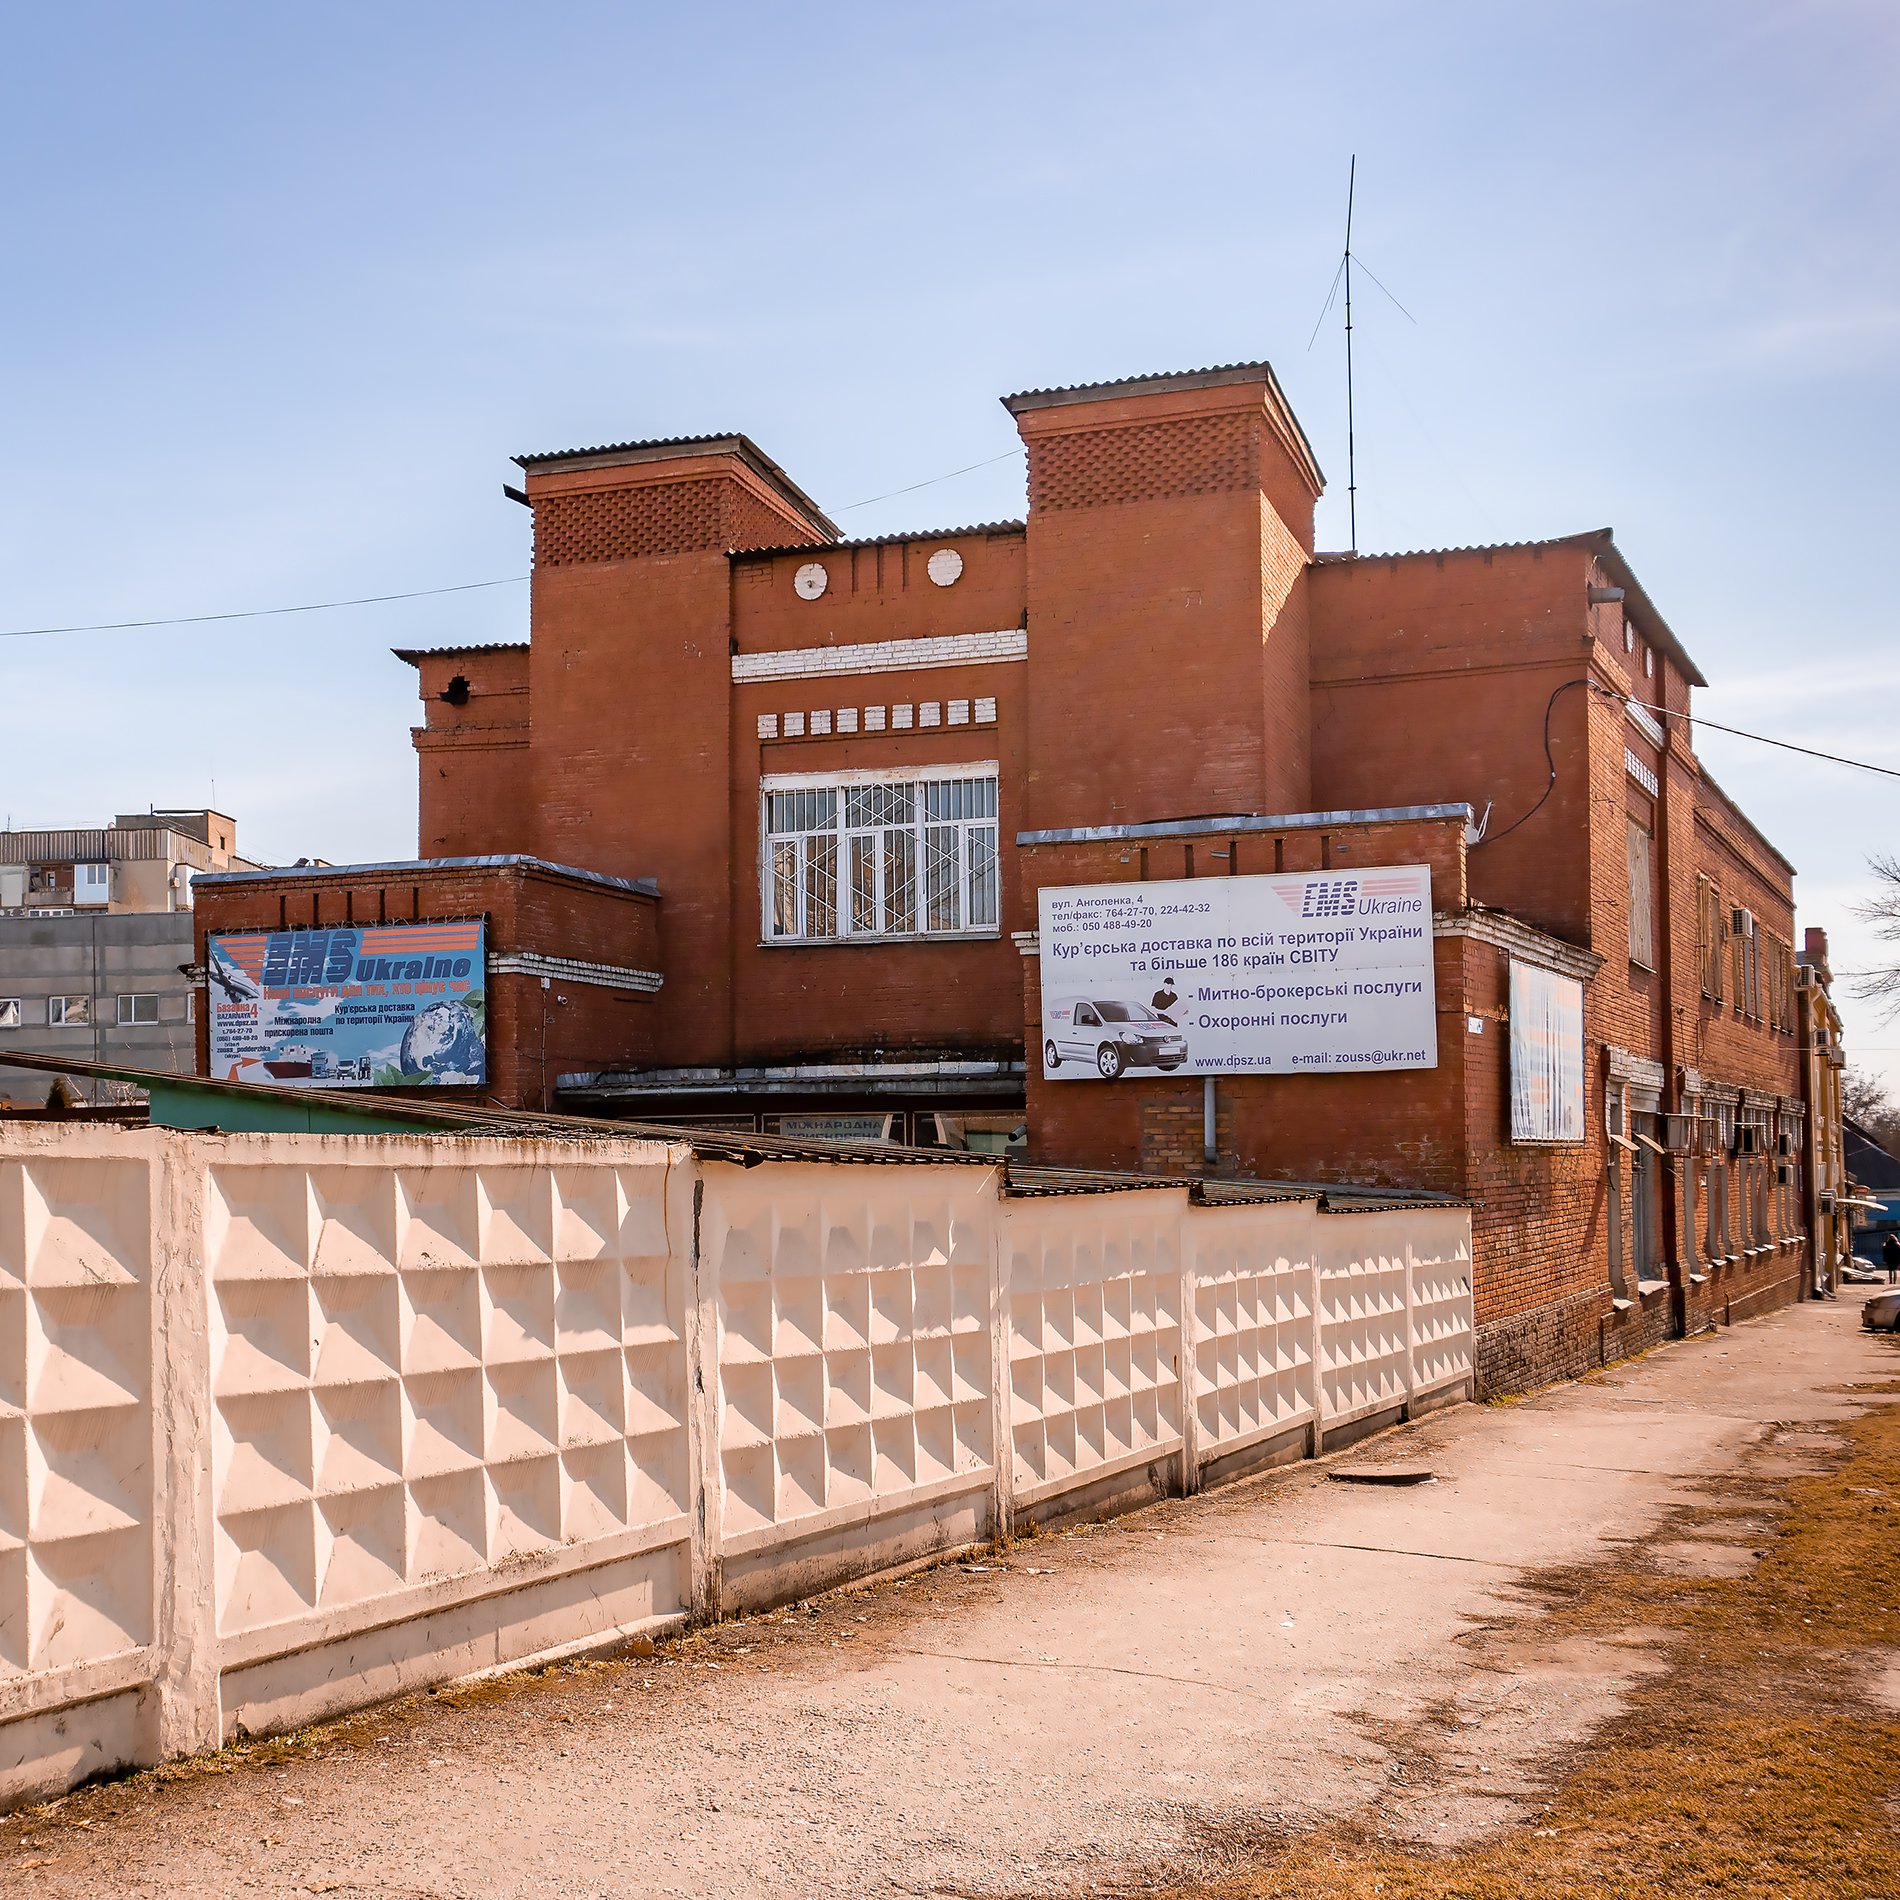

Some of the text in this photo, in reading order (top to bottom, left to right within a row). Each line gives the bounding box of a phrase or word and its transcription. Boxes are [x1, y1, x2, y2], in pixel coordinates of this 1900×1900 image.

[1052, 895, 1143, 910] вул. Анголенка, 4
[1302, 881, 1422, 917] EMS Ukraine
[1052, 903, 1210, 921] тел/факс: 764-27-70, 224-42-32
[1052, 919, 1152, 933] моб.: 050 488-49-20
[1052, 925, 1423, 959] Кур’єрська доставка по всій території України
[1130, 948, 1339, 971] та більше 186 країн СВІТУ
[392, 982, 411, 995] хто
[449, 980, 470, 992] час
[1198, 981, 1422, 1001] Митно-брокерські послуги
[250, 1003, 258, 1018] 4
[378, 1003, 415, 1013] доставка
[274, 1015, 321, 1026] Міжнародна
[336, 1013, 415, 1025] по території України
[1199, 1012, 1348, 1030] Охоронні послуги
[264, 1027, 334, 1039] прискорена пошта
[1195, 1049, 1426, 1068] www.dpsz.ua e-mail: zouss@ukr.net
[786, 1121, 882, 1129] МІЖНАРОДНА
